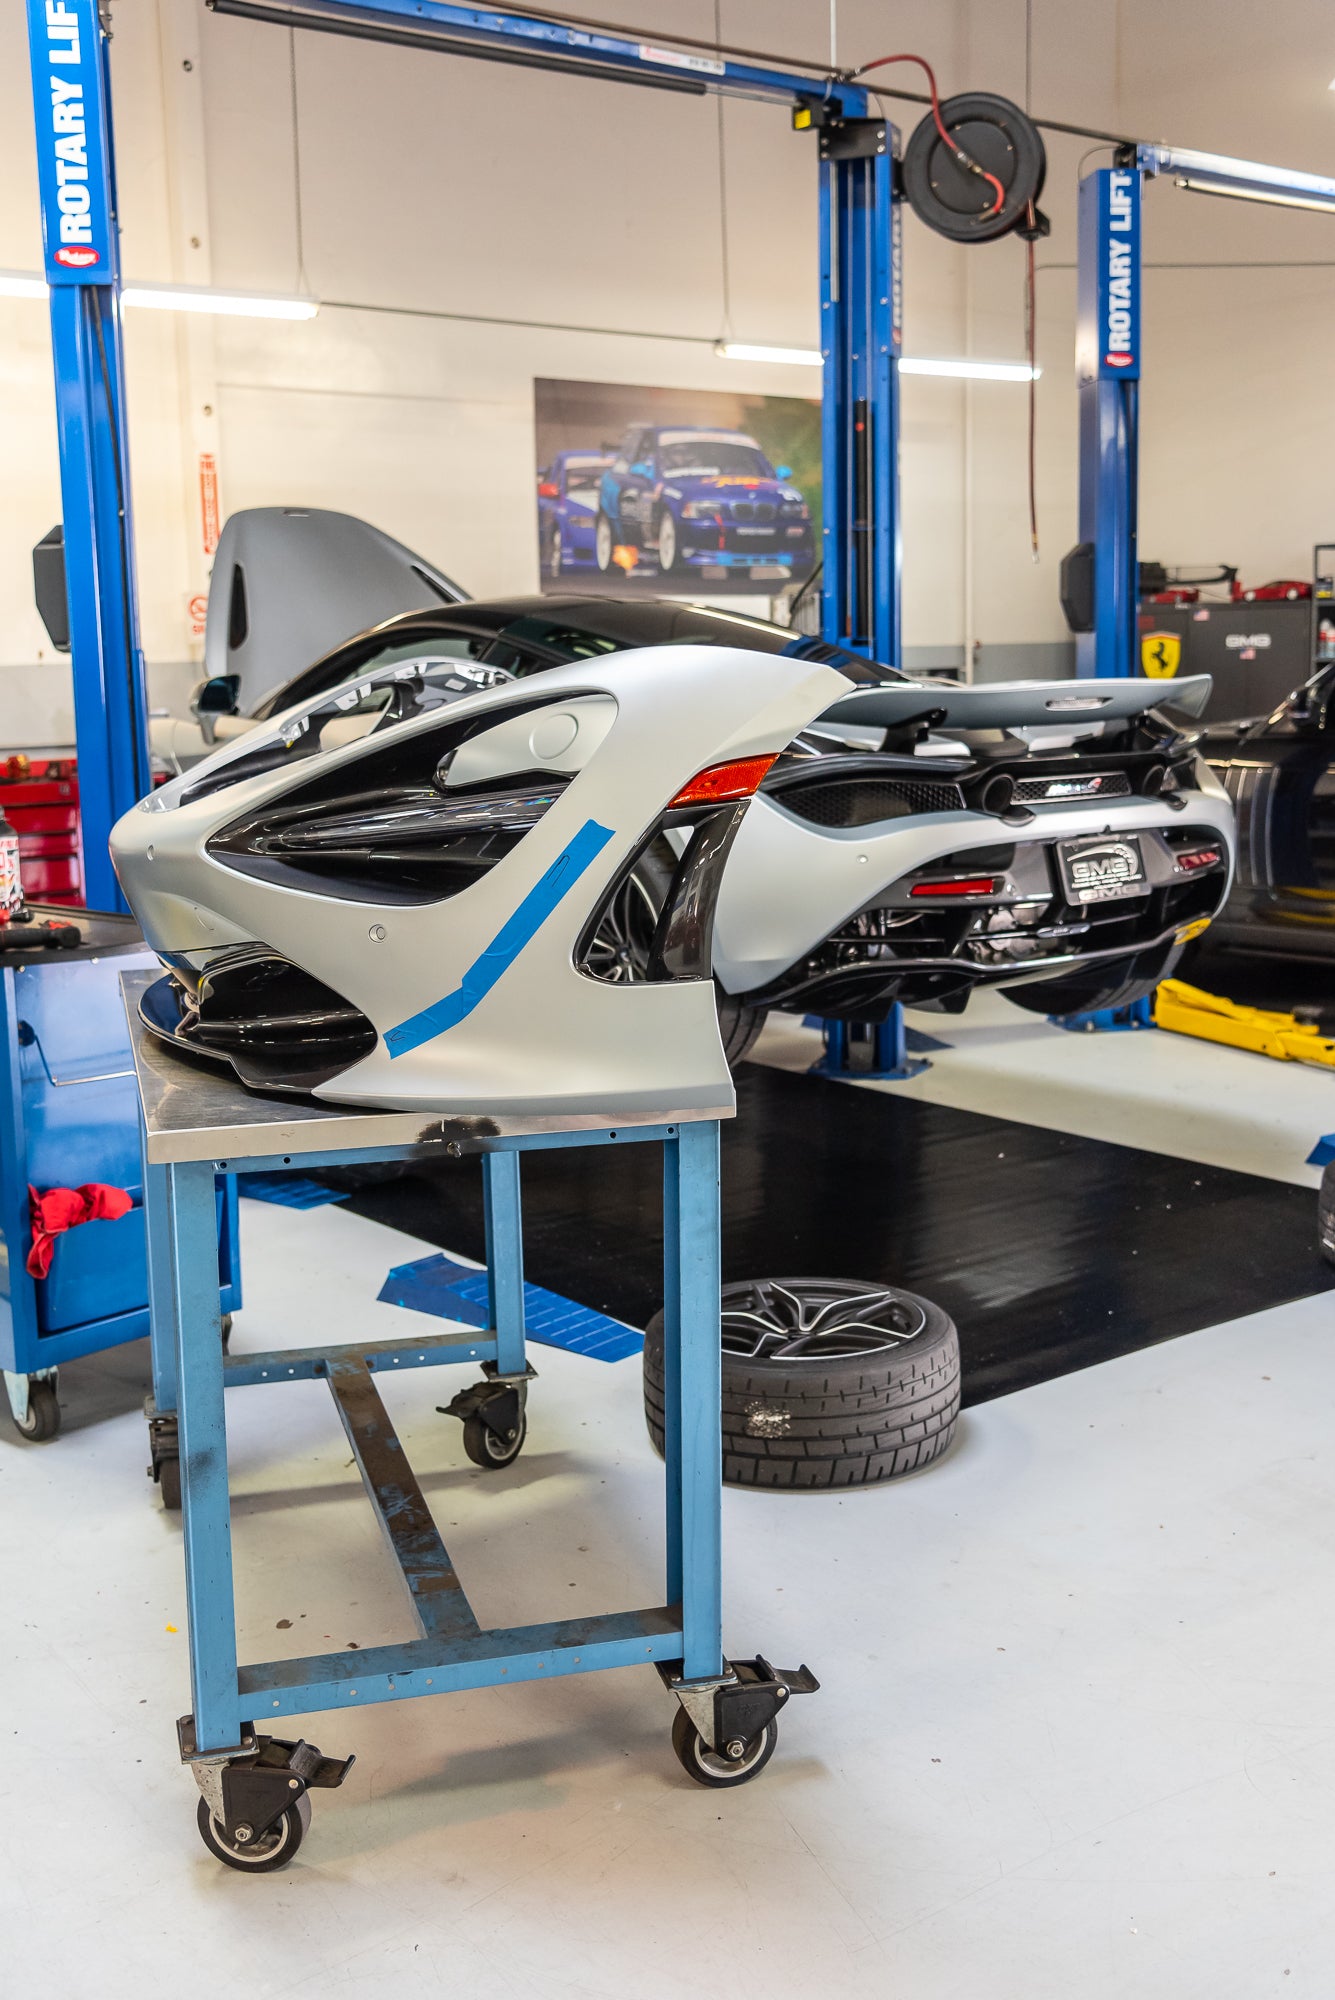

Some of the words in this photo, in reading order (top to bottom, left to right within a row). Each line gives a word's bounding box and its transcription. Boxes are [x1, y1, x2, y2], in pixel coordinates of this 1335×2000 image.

[45, 0, 81, 64] LIF
[50, 75, 93, 244] ROTARY
[1109, 171, 1133, 232] LIFT
[1108, 238, 1132, 352] ROTARY
[1072, 857, 1129, 878] GMG
